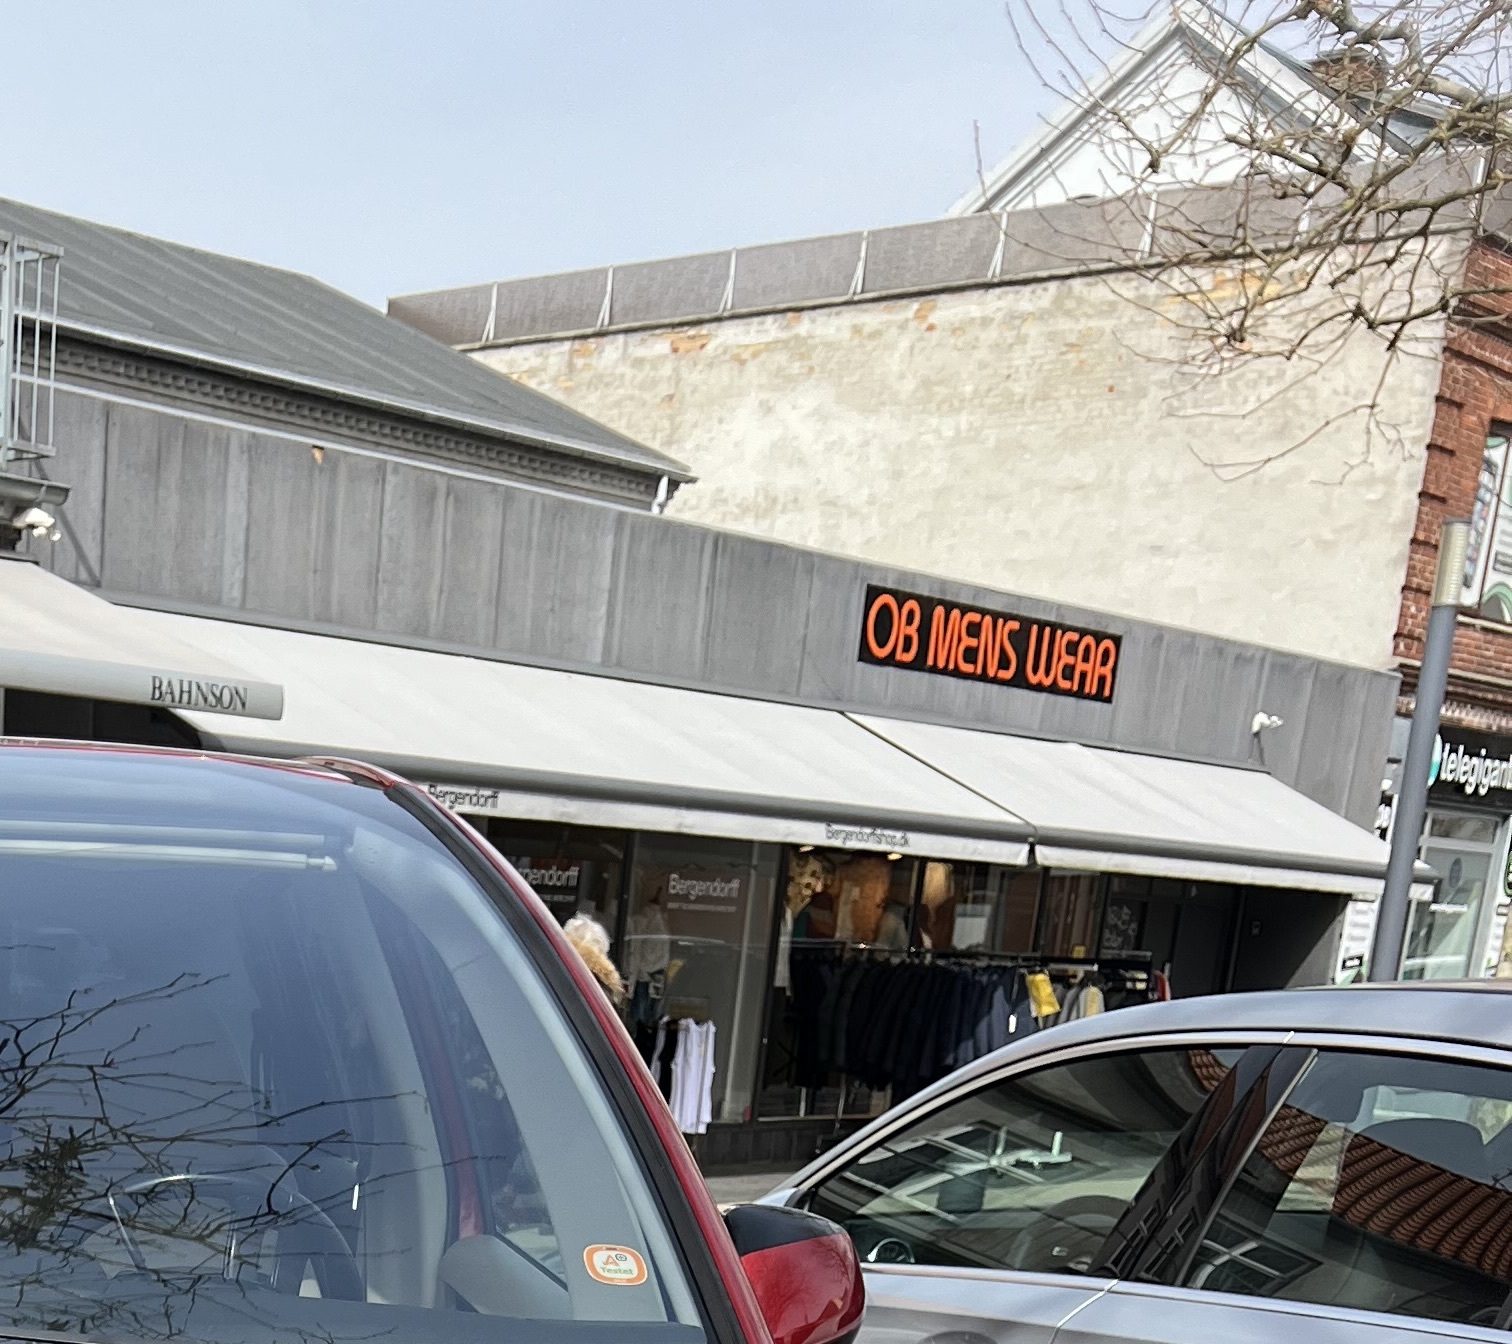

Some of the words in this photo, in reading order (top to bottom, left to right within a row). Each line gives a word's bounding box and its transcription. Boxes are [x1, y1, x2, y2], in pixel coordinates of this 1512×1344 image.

[867, 593, 921, 663] OB
[927, 605, 1020, 680] MENS
[1026, 624, 1116, 698] WEAR
[151, 675, 248, 711] BAHNSON
[668, 873, 740, 900] Bergendorff
